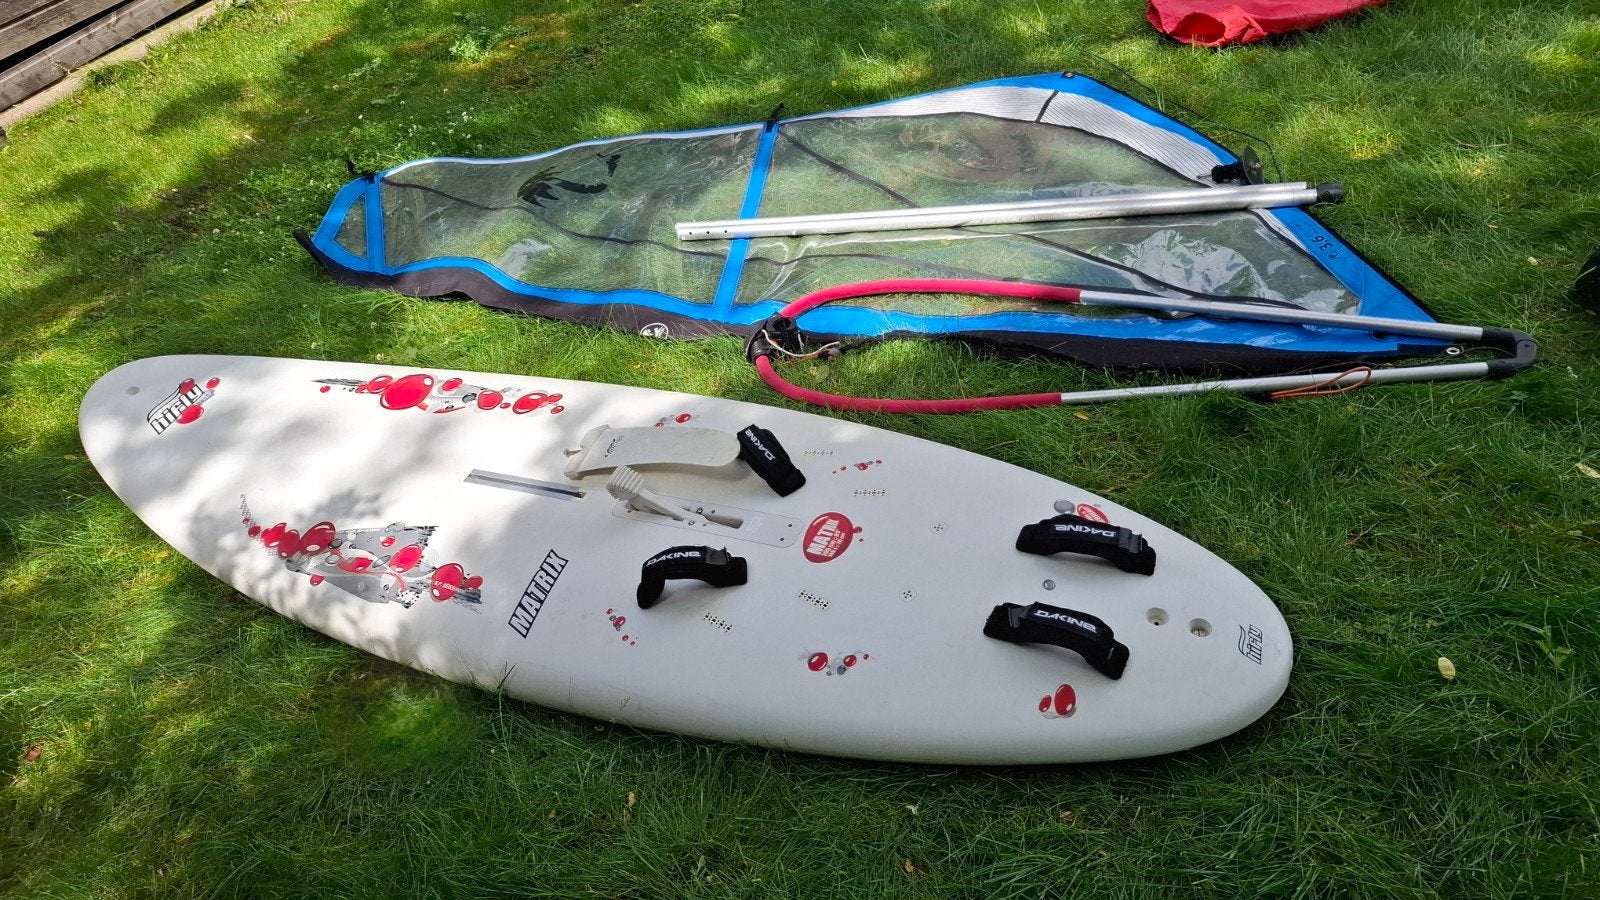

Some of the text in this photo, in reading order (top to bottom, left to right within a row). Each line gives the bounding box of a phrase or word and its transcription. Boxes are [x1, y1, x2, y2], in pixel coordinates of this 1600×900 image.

[745, 428, 776, 461] DAKINE
[806, 518, 840, 555] MATRIX
[1055, 524, 1117, 538] DAKINE
[646, 551, 701, 566] DAKINE
[508, 548, 569, 638] MATRIX
[1033, 609, 1097, 633] DAKINE
